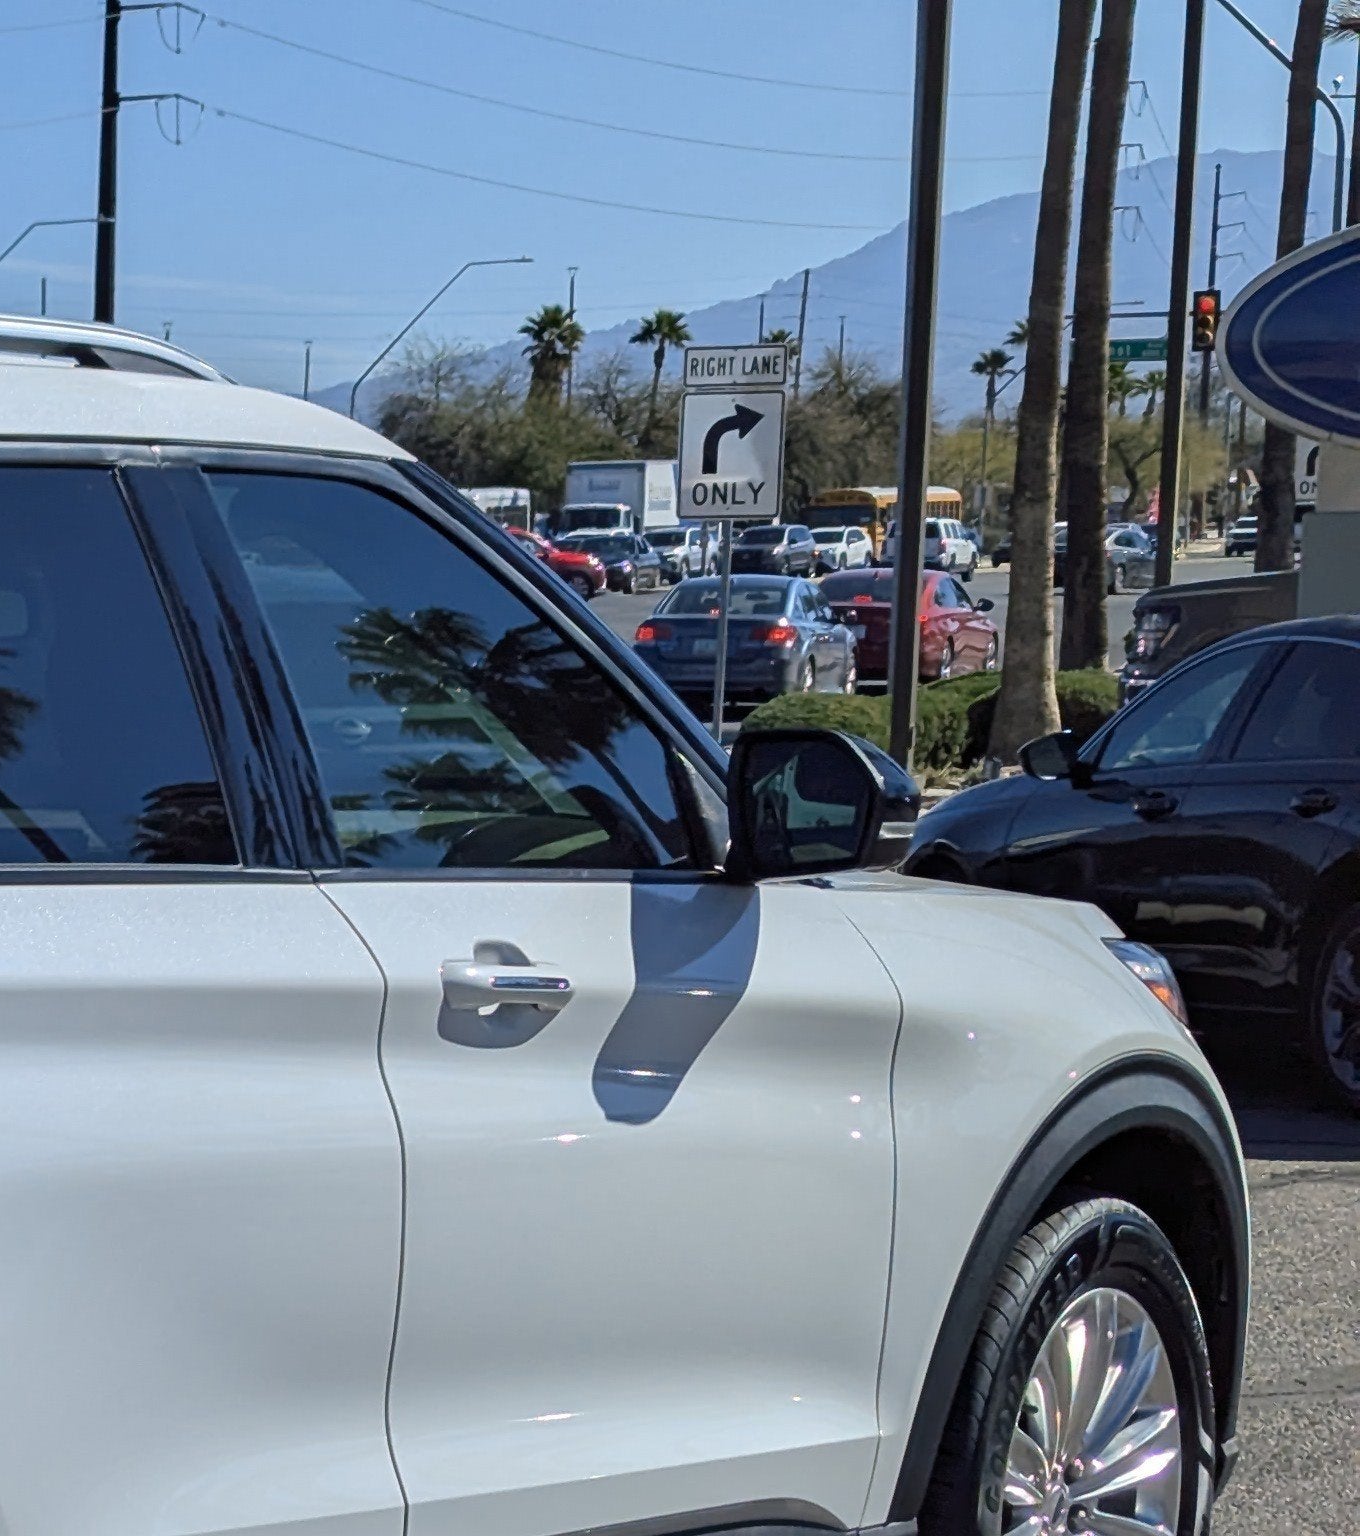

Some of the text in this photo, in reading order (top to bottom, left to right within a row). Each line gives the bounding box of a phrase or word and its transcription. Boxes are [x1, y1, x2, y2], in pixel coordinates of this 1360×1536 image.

[689, 355, 781, 377] RIGHT LANE
[692, 480, 765, 506] ONLY
